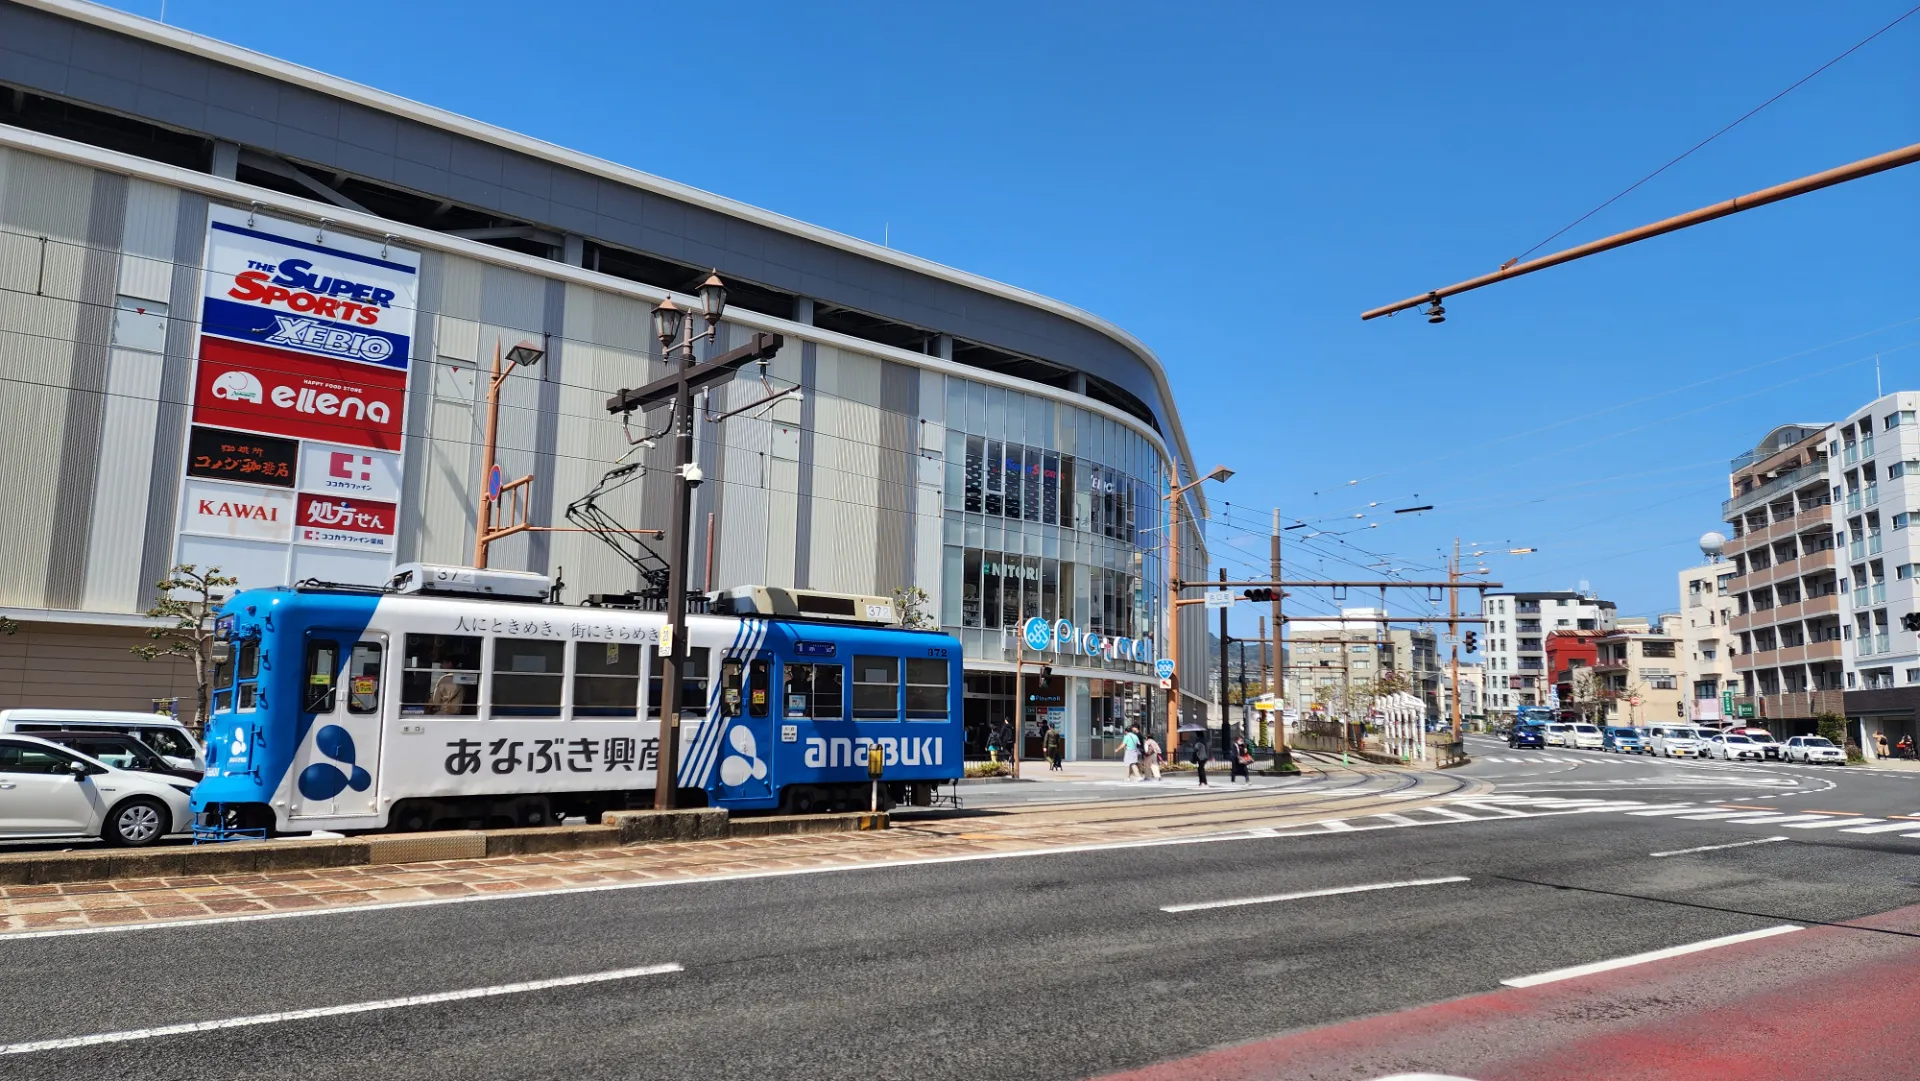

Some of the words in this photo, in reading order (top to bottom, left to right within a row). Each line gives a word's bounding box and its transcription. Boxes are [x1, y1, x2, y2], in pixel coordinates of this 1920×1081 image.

[247, 260, 277, 274] THE
[272, 258, 396, 309] SUPER
[227, 270, 381, 325] SPORTS
[265, 315, 394, 362] XEBIO
[303, 379, 324, 388] HAPPY
[325, 382, 341, 390] FOOD
[343, 385, 363, 394] STORE
[271, 385, 390, 424] ellena
[325, 480, 372, 491] ココカラファイン
[198, 499, 278, 522] KAWAI
[307, 500, 385, 529] 処方せん
[991, 562, 1039, 581] NITORI
[868, 605, 889, 617] 372
[928, 648, 948, 657] 372
